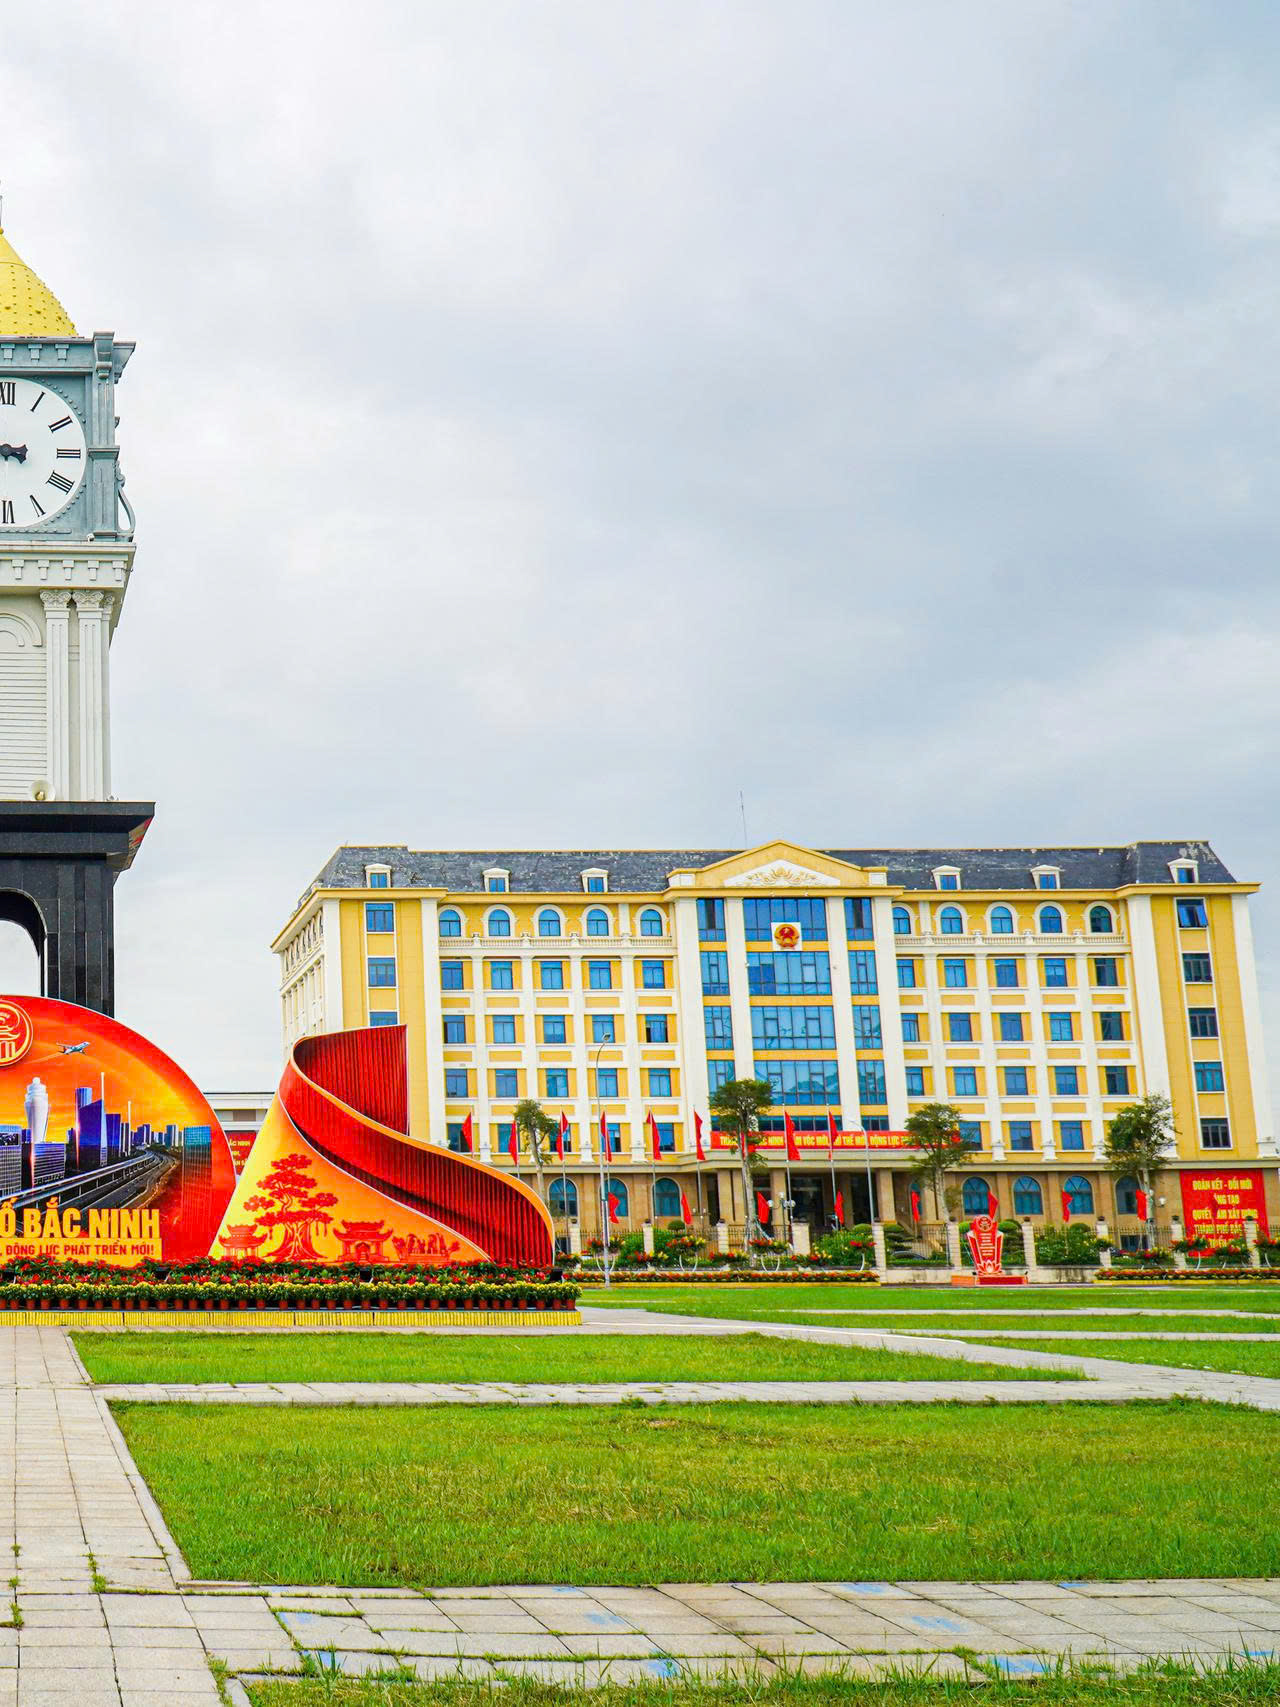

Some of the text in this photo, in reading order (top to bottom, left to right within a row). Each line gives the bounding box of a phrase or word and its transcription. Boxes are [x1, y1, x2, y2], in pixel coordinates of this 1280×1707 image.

[30, 392, 46, 412] I
[48, 416, 73, 433] II
[57, 448, 81, 459] III
[2, 500, 15, 523] VI
[30, 495, 46, 517] V
[23, 1196, 81, 1239] BẮC
[88, 1208, 160, 1239] NINH
[6, 1242, 35, 1257] ĐỘNG
[39, 1243, 60, 1256] LỰC
[63, 1242, 92, 1256] PHÁT
[94, 1240, 127, 1256] TRIỂN
[131, 1242, 154, 1256] MỚI!
